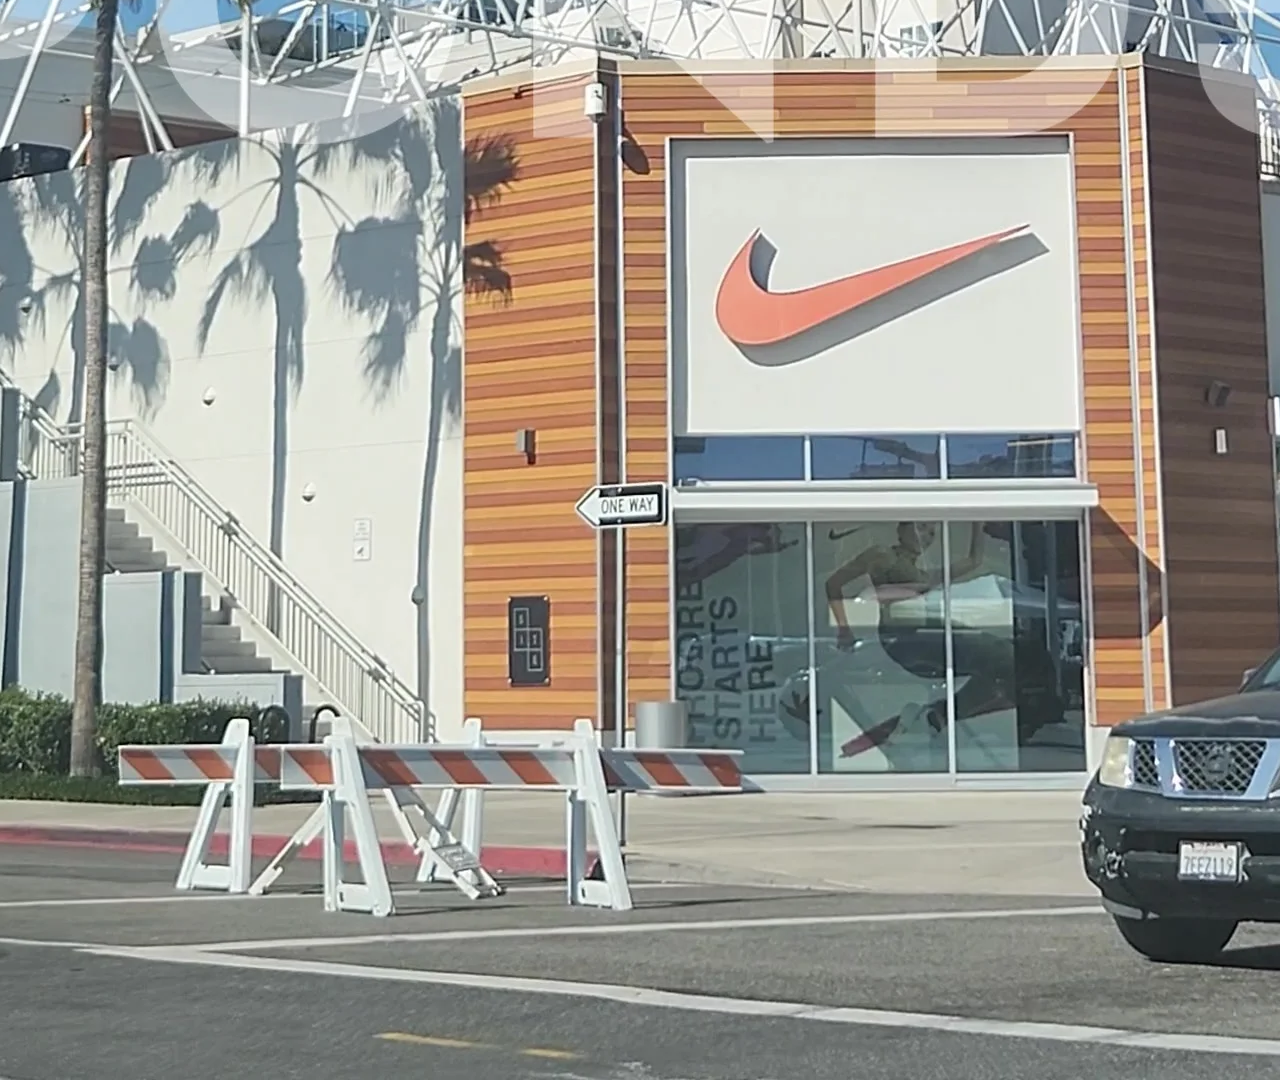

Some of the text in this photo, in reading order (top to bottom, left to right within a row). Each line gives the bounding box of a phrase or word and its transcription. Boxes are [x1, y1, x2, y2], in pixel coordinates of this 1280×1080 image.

[601, 497, 654, 514] ONE WAY
[708, 595, 742, 741] STARTS
[745, 640, 776, 743] HERE
